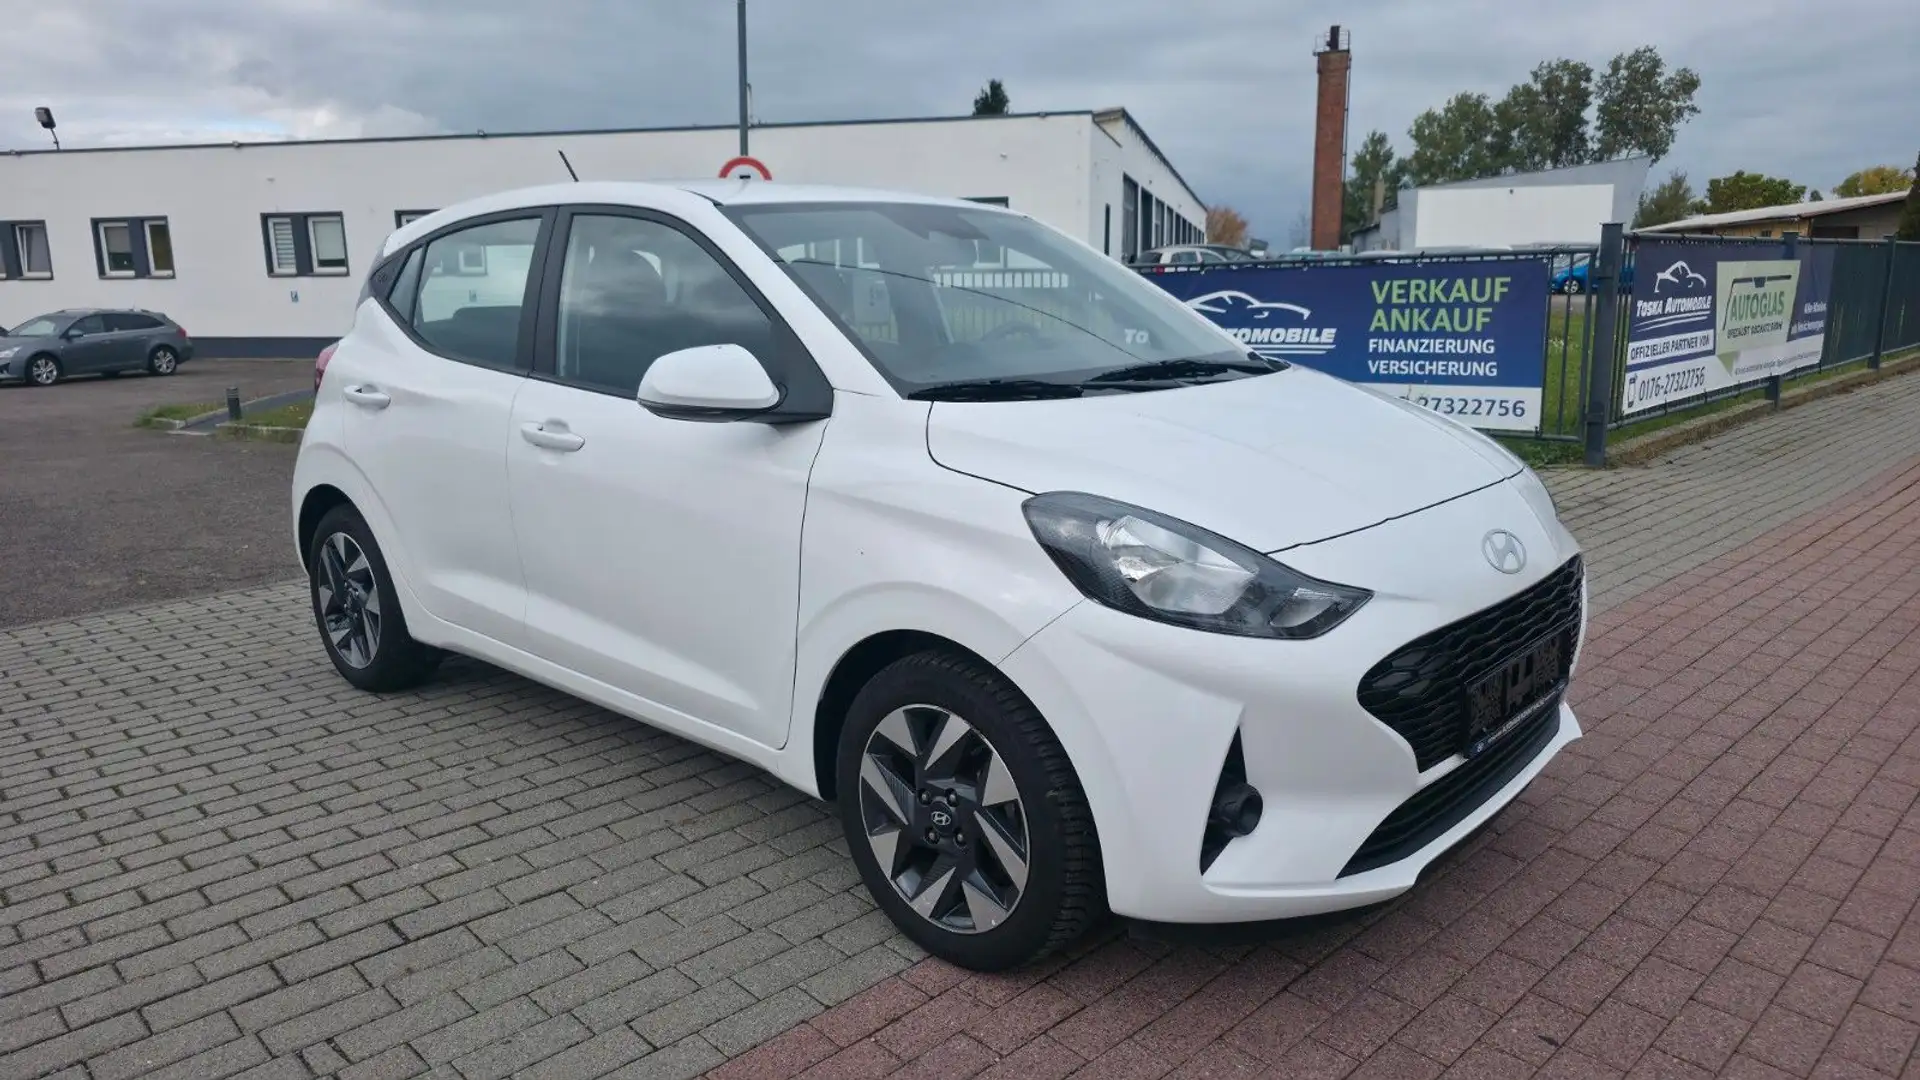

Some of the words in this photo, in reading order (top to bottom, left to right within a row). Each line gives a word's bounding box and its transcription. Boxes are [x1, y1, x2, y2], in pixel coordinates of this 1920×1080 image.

[1371, 277, 1511, 303] VERKAUF
[1636, 299, 1663, 317] TOSKA
[1665, 295, 1713, 315] AUTOMOBILE
[1730, 291, 1785, 321] AUTOGLAS
[1369, 308, 1493, 332] ANKAUF
[1124, 329, 1149, 344] TO
[1368, 338, 1496, 354] FINANZIERUNG
[1630, 342, 1670, 361] OFFIZIELLER
[1670, 336, 1700, 352] PARTNER
[1367, 360, 1498, 377] VERSICHERUNG
[1638, 366, 1706, 401] 0176-27322756
